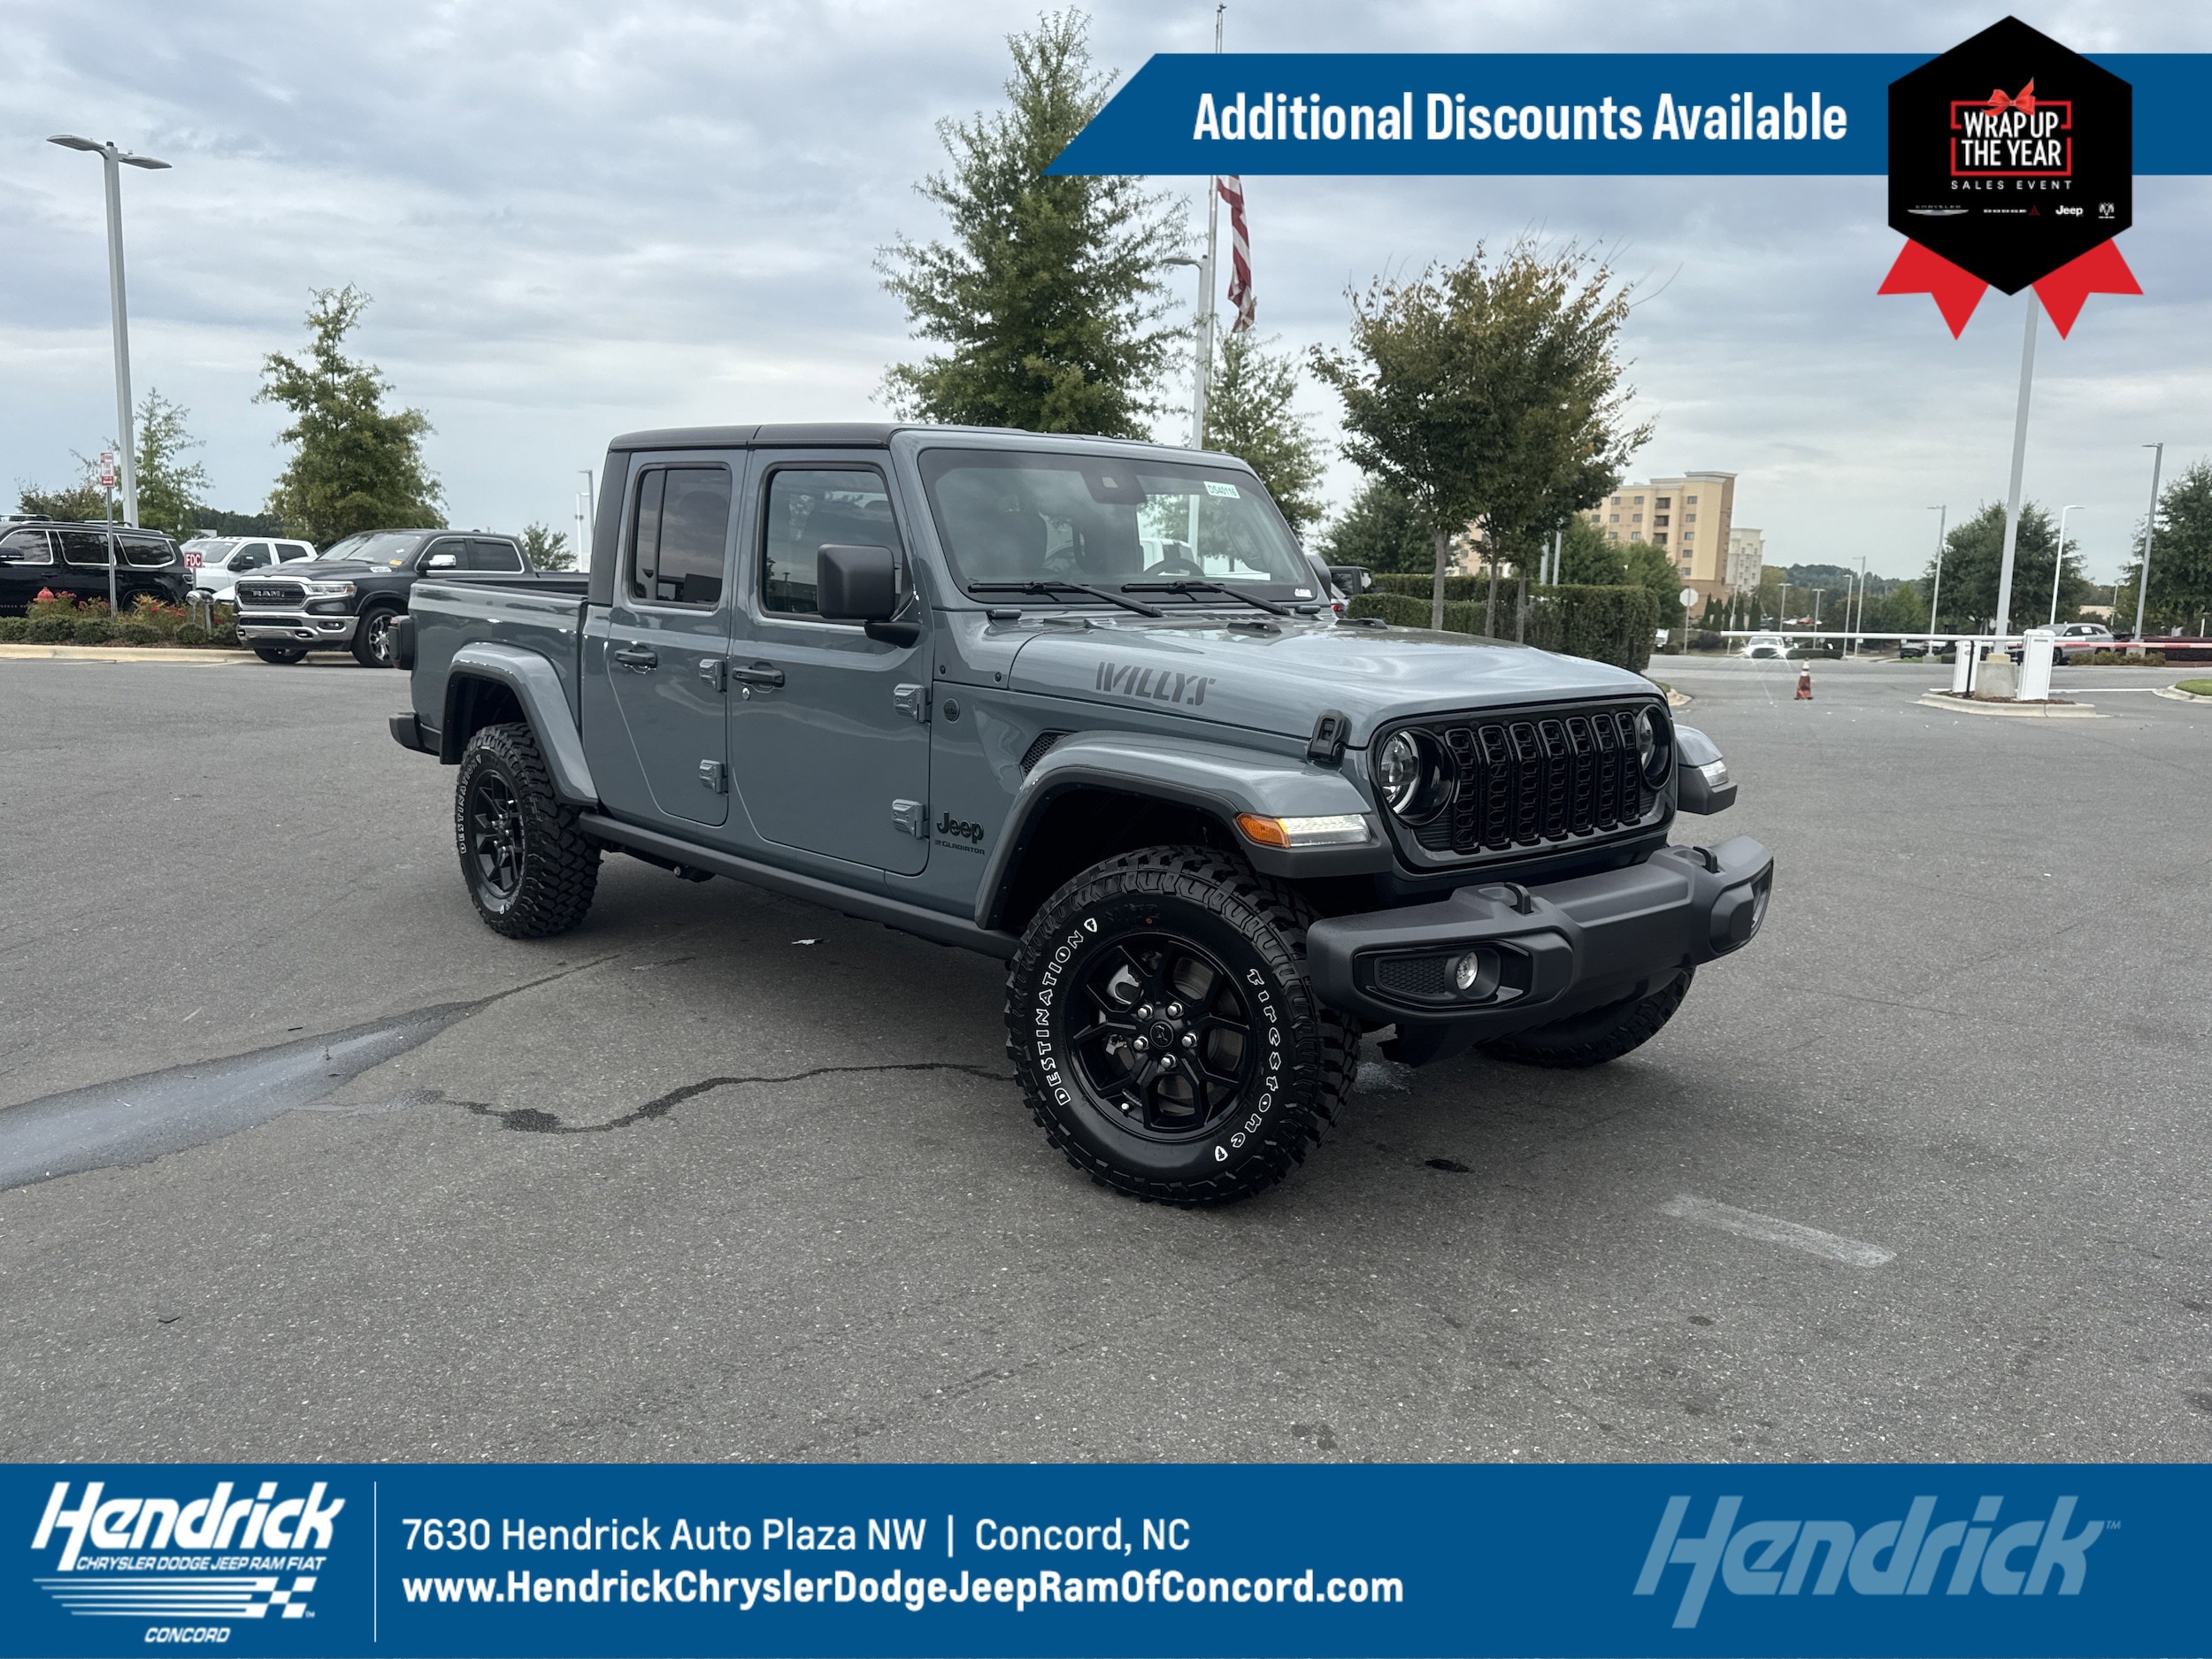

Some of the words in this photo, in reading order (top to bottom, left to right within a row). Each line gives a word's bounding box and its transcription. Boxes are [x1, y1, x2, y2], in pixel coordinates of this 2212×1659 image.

[186, 554, 202, 567] FDC
[1095, 661, 1217, 706] WILLYS
[937, 810, 984, 844] Jeep
[942, 841, 986, 856] GLADIATOR
[1035, 930, 1085, 1105] DESTINATION
[1230, 968, 1282, 1148] Firestone
